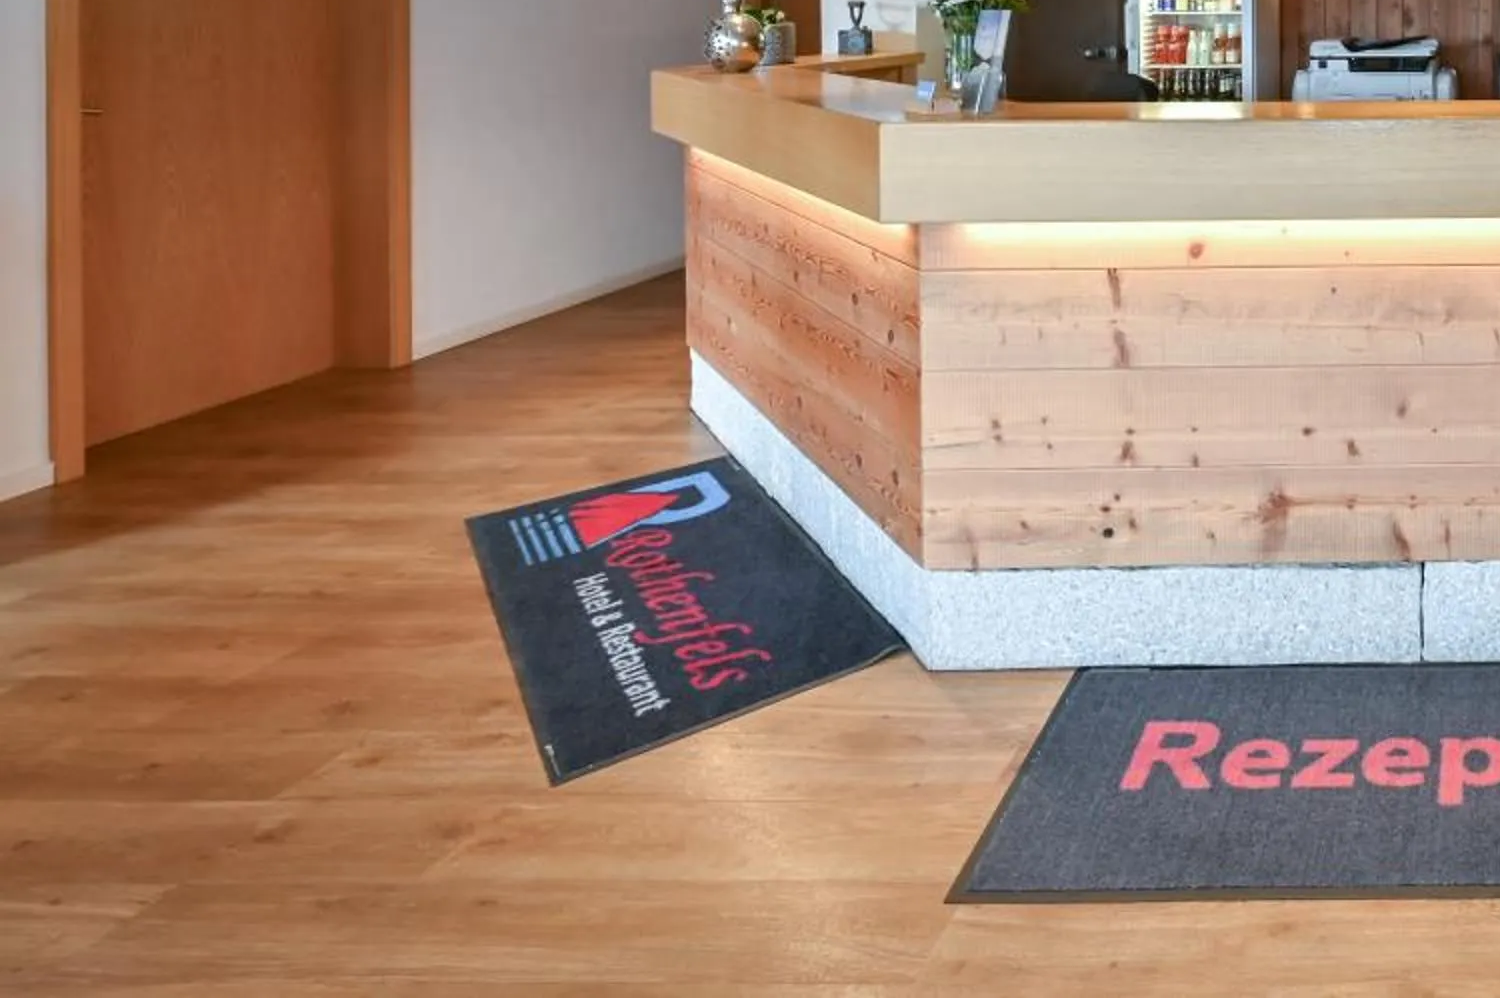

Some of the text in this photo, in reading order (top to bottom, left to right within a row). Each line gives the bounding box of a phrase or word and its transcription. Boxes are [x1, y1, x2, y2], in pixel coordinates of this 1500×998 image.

[573, 573, 671, 718] Hotel & Restaurant
[605, 528, 772, 690] Rothenfels
